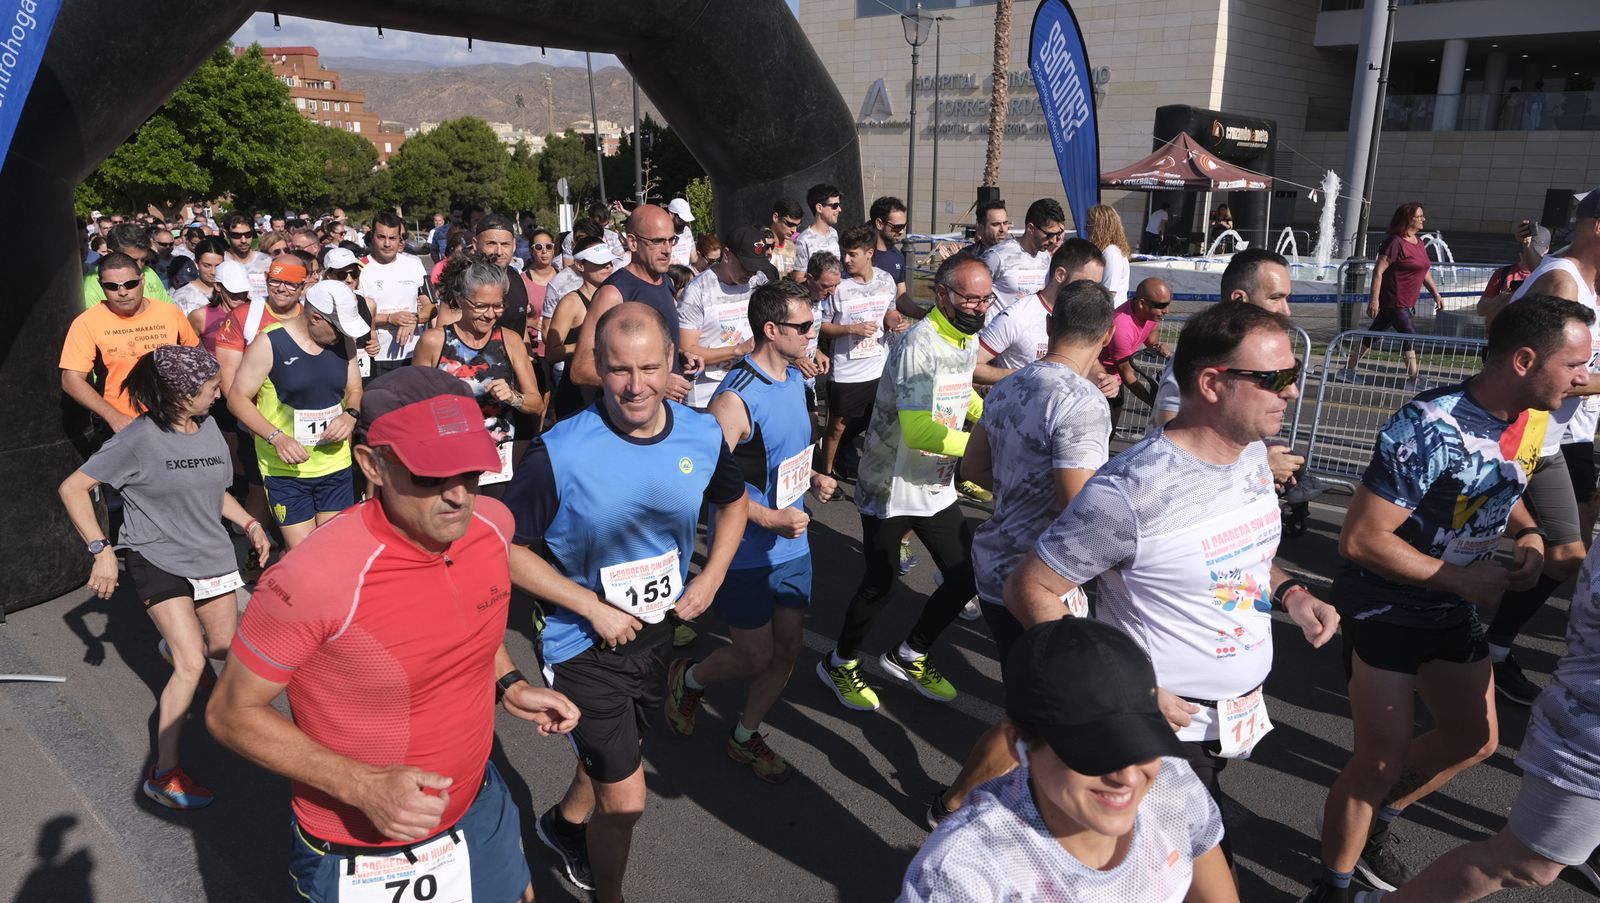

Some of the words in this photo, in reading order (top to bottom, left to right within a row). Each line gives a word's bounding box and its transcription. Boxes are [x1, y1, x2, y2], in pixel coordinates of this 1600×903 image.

[929, 123, 973, 135] HSPITAL
[135, 333, 159, 342] CIUDAD
[166, 455, 225, 470] EXCEPTIONAL
[783, 461, 809, 490] 1102
[625, 574, 672, 607] 153
[385, 873, 438, 903] 70
